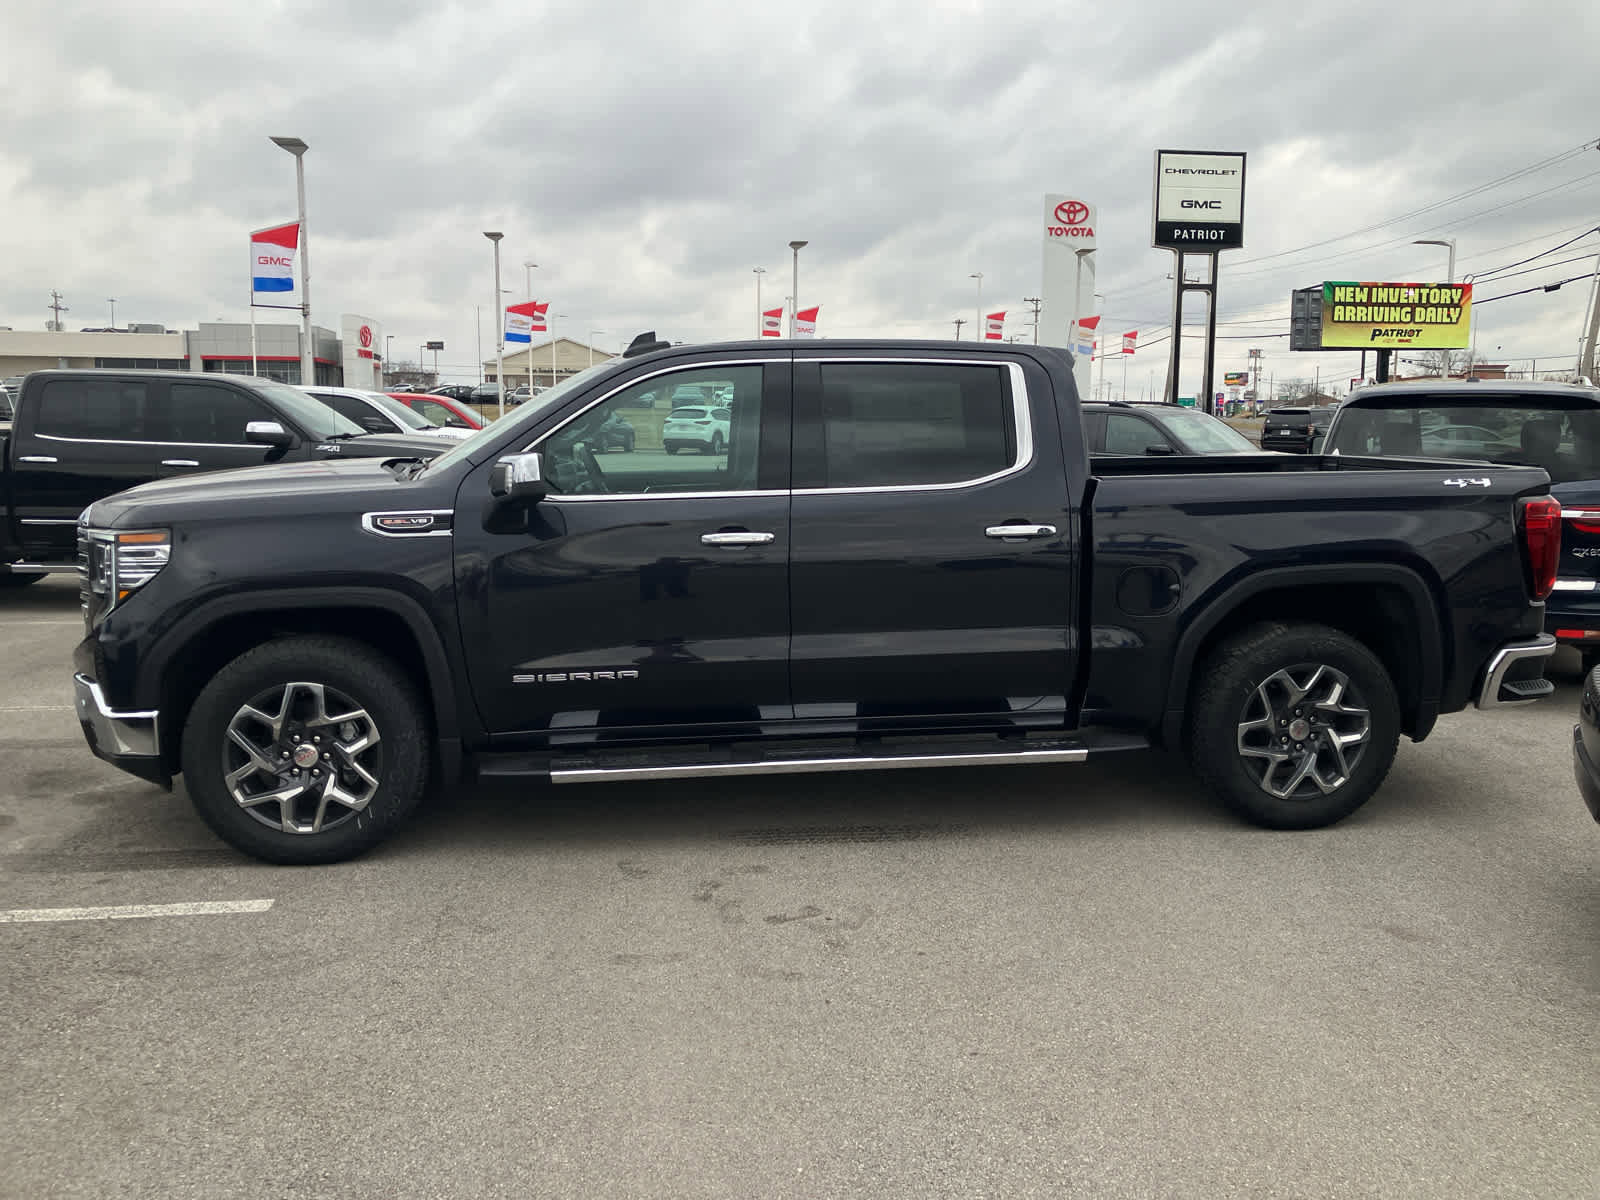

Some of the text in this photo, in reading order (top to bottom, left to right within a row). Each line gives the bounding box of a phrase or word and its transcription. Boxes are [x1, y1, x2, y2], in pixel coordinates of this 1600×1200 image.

[1181, 199, 1222, 209] GMC
[1047, 226, 1094, 237] TOYOTA
[1174, 229, 1225, 240] PATRIOT
[258, 256, 292, 267] GMC
[1335, 286, 1462, 304] NEW INVENTORY
[1333, 305, 1460, 323] ARRIVING DAILY
[1370, 328, 1423, 341] PATRIOT
[512, 670, 639, 683] SIERRA
